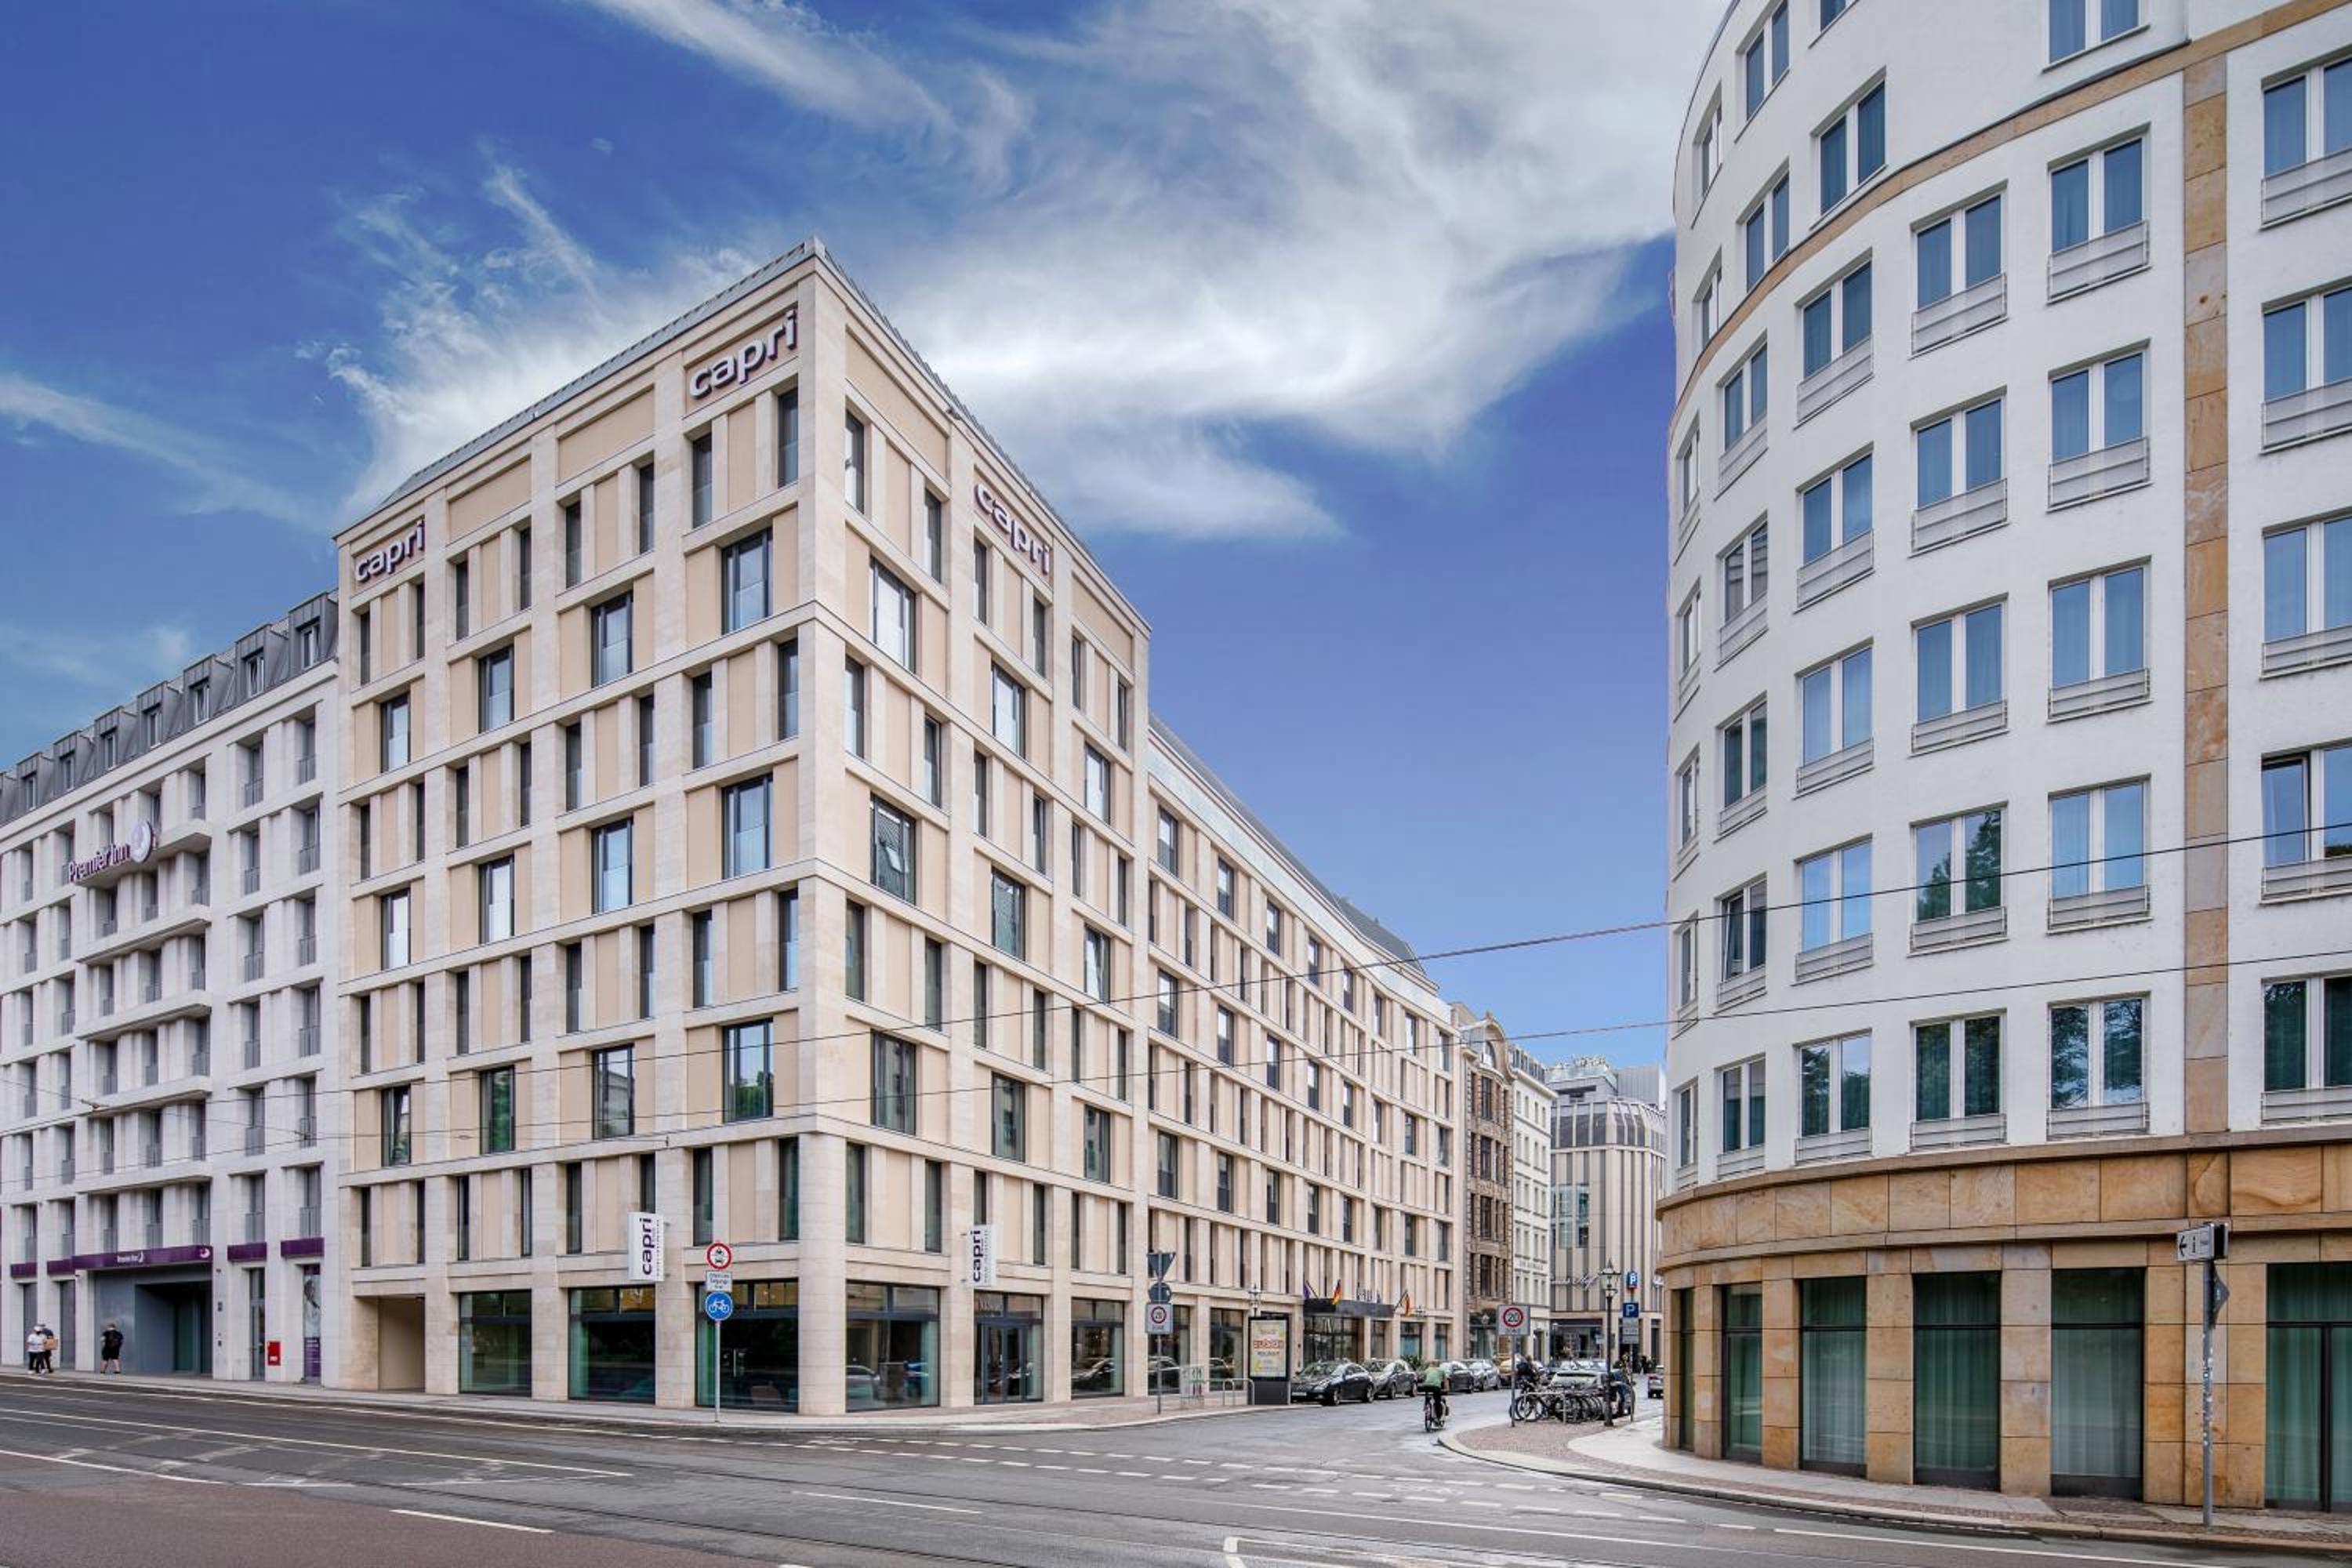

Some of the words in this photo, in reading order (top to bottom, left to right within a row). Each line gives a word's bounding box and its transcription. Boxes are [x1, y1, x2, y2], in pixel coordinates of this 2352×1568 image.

[689, 310, 797, 399] capri
[355, 521, 426, 583] capri
[974, 484, 1050, 575] capri
[68, 850, 111, 883] Premier
[111, 843, 130, 866] Inn
[639, 1218, 655, 1276] capri
[971, 1230, 984, 1283] capri
[1508, 1312, 1519, 1323] 20
[1625, 1304, 1635, 1316] P
